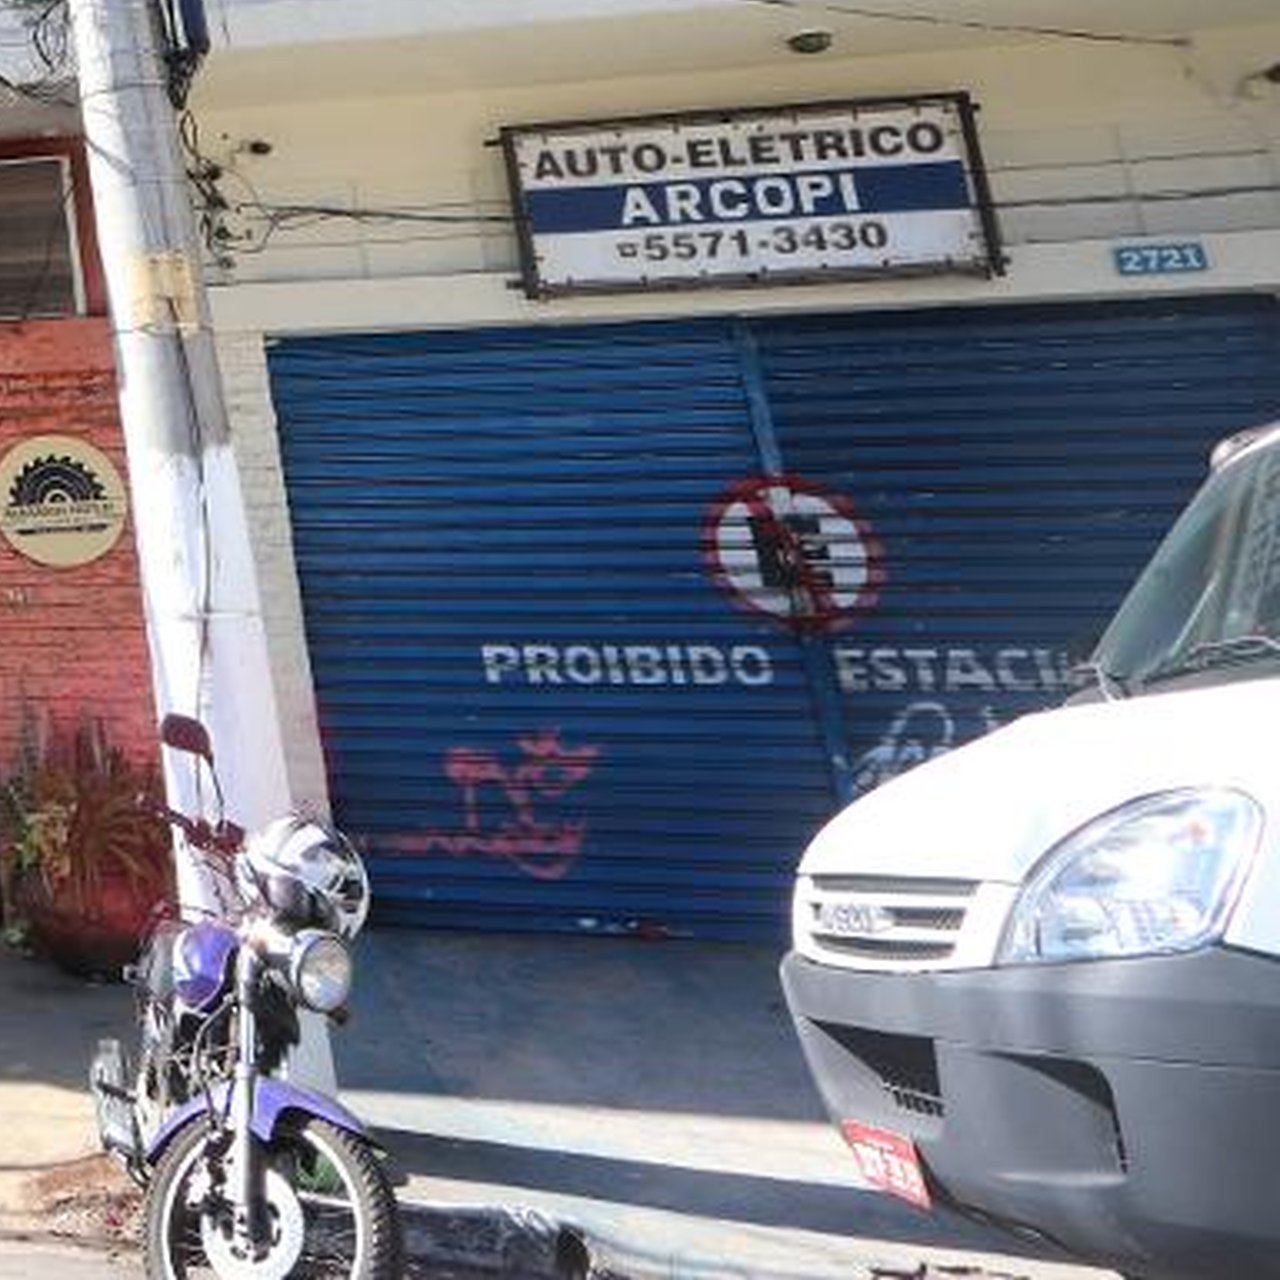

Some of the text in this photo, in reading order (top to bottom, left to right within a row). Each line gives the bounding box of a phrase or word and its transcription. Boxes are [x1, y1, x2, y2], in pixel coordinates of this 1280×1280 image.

[534, 122, 944, 180] AUTO-ELÉTRICO
[621, 173, 861, 226] ARCOPI
[644, 222, 887, 261] 5571-3430
[1120, 248, 1202, 272] 2721
[482, 645, 1071, 691] PROIBIDO ESTACI
